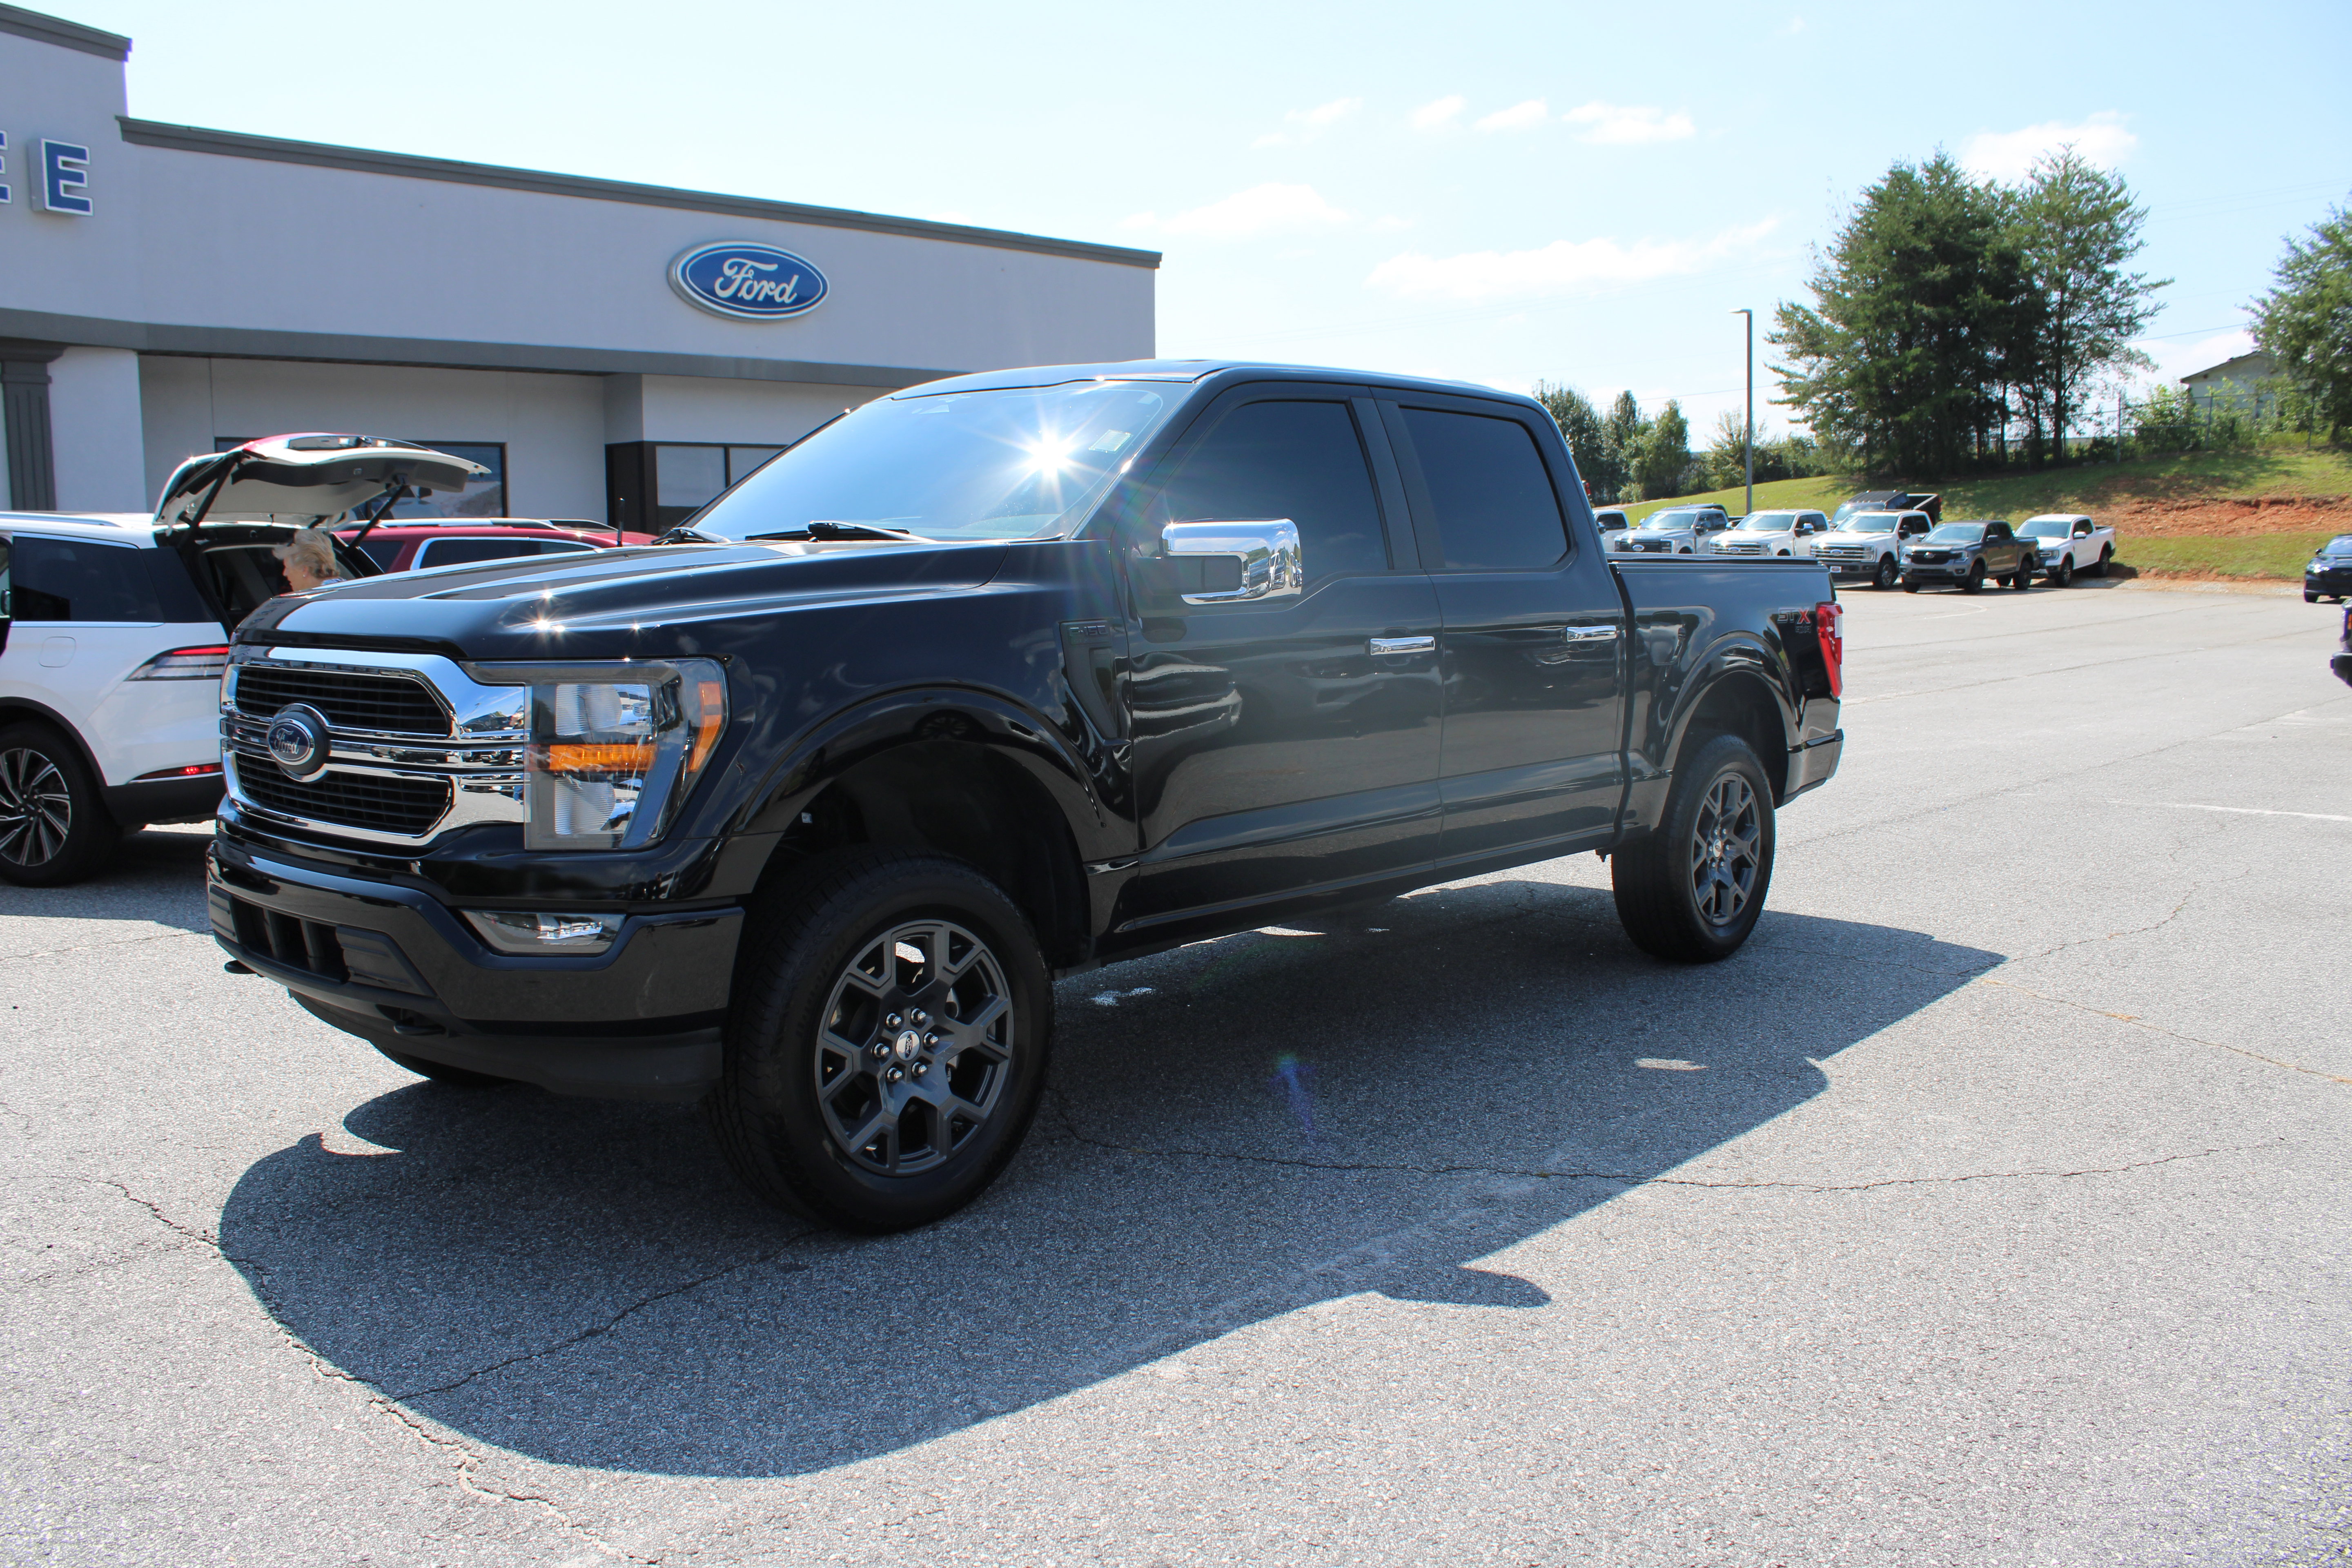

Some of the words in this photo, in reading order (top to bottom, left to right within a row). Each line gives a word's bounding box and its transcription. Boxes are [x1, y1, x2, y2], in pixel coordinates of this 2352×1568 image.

[715, 258, 799, 304] Ford
[1777, 606, 1811, 624] STX
[274, 727, 300, 755] Ford
